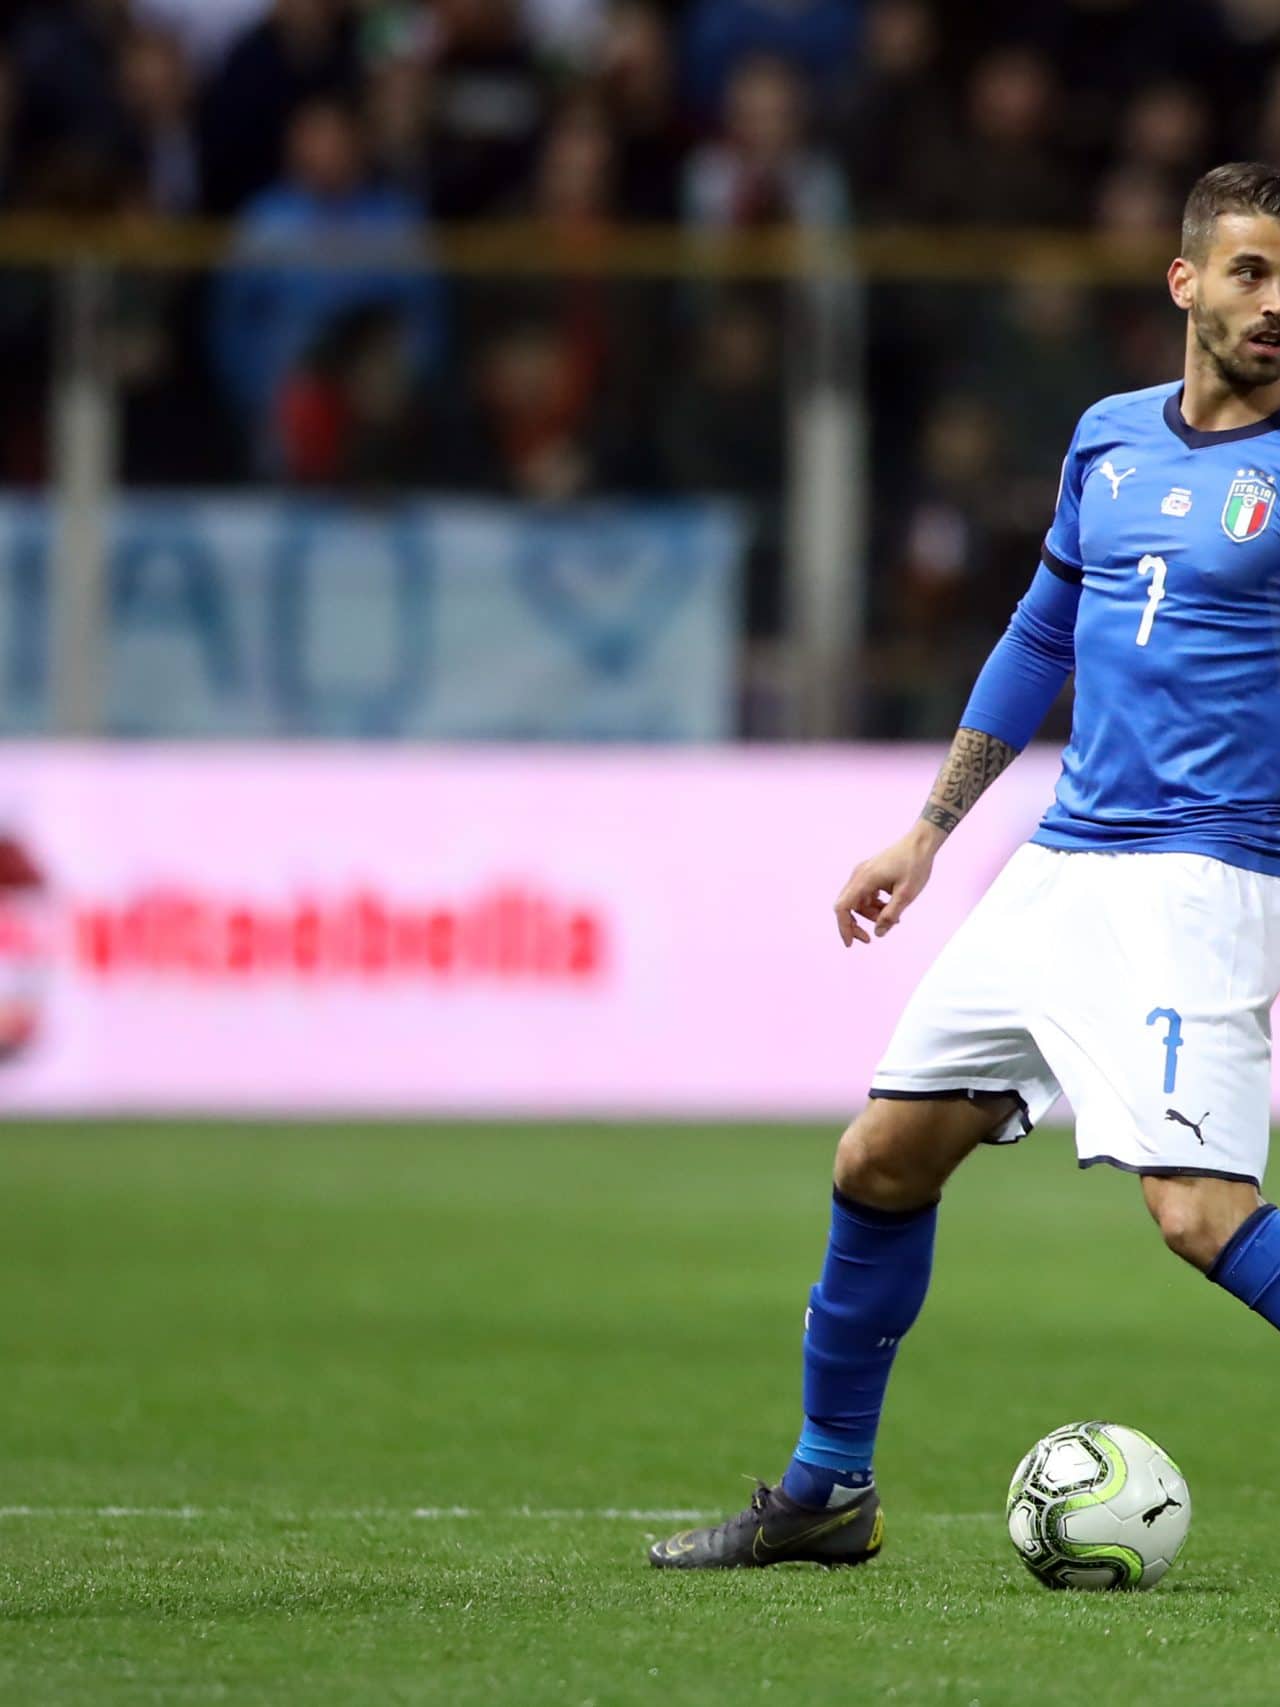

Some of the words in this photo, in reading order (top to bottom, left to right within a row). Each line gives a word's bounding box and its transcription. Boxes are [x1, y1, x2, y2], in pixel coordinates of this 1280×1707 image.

[1234, 484, 1273, 499] ITALIA
[1136, 554, 1168, 647] 7
[1146, 1007, 1184, 1094] 7
